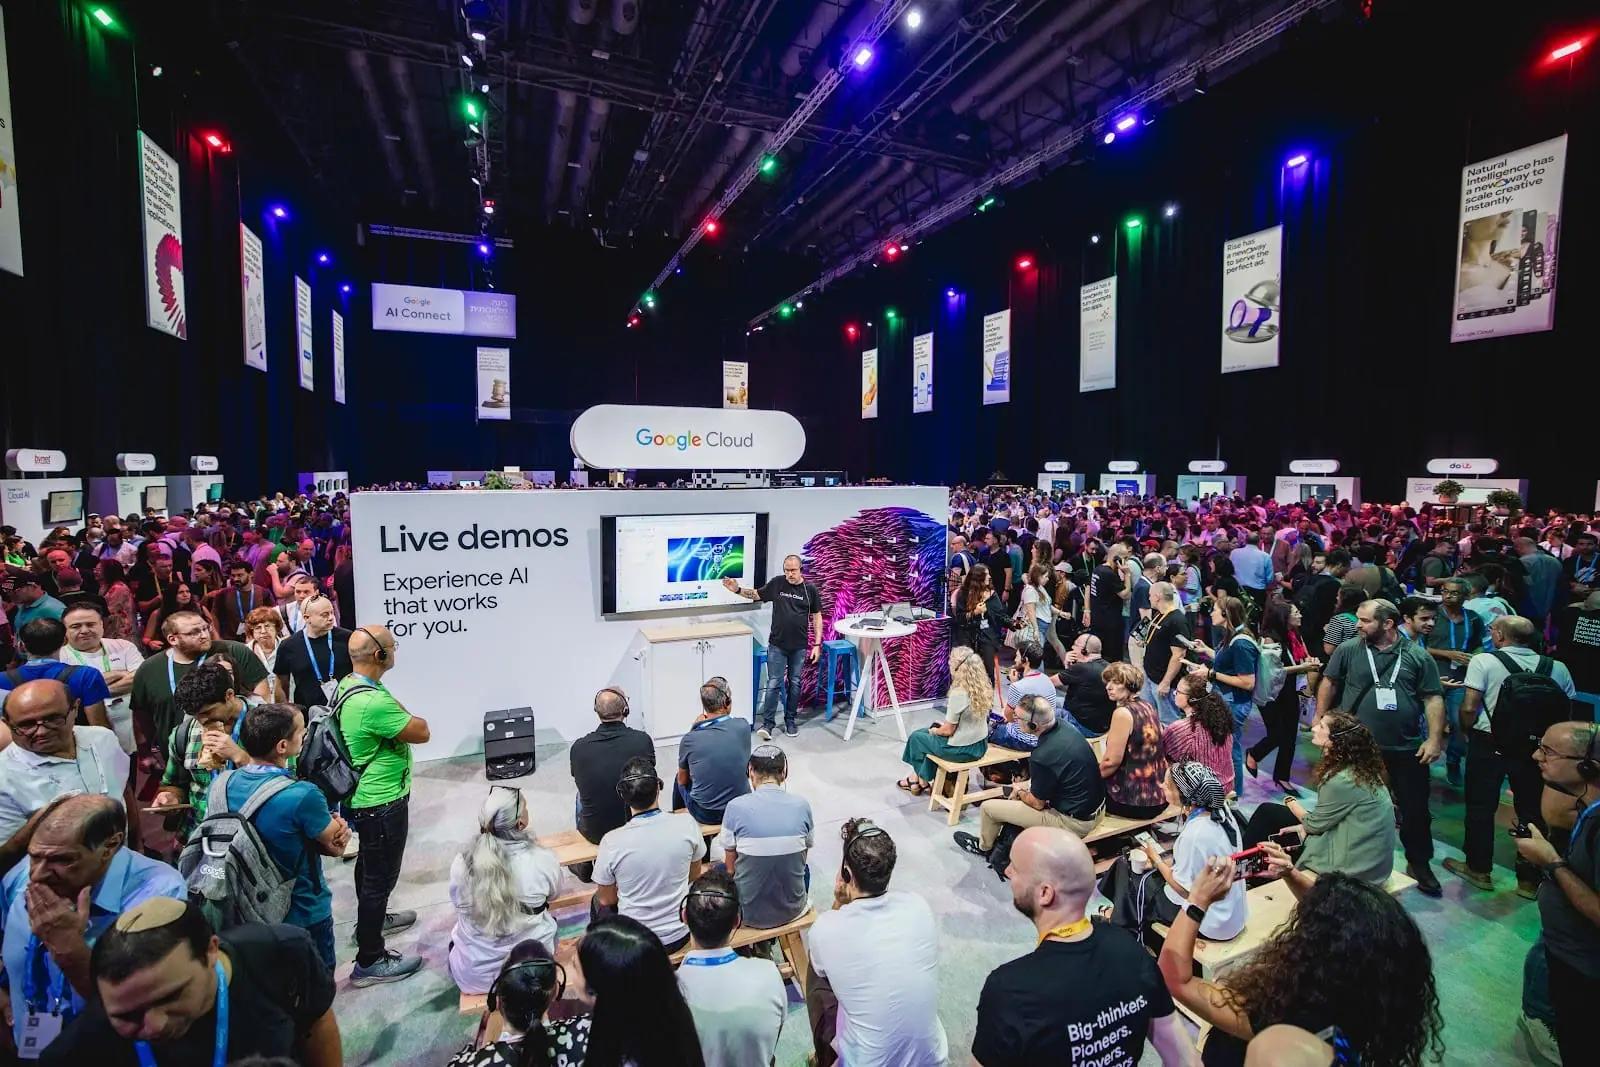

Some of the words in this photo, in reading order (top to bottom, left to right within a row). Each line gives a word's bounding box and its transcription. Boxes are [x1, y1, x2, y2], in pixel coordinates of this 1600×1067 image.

[1466, 162, 1531, 186] Intelligence
[1533, 156, 1554, 167] has
[1467, 159, 1508, 178] Natural
[1465, 191, 1493, 204] scale
[1495, 178, 1543, 196] creative
[1474, 182, 1496, 193] new
[1508, 172, 1530, 184] way
[1532, 168, 1545, 177] to
[1464, 195, 1514, 213] instantly.
[1226, 262, 1253, 275] perfect
[1235, 254, 1255, 264] serve
[404, 297, 431, 306] Google
[385, 308, 398, 317] AI
[401, 308, 451, 320] Connect
[636, 428, 701, 450] Google
[706, 432, 753, 448] Cloud
[380, 524, 449, 552] Live
[458, 524, 569, 550] demos
[384, 570, 503, 594] Experience
[509, 567, 528, 584] AI
[384, 597, 428, 614] that
[434, 592, 498, 612] works
[385, 620, 417, 637] for
[423, 619, 468, 639] you.
[1067, 995, 1148, 1042] Big-thinkers.
[1071, 1025, 1132, 1062] Pioneers.
